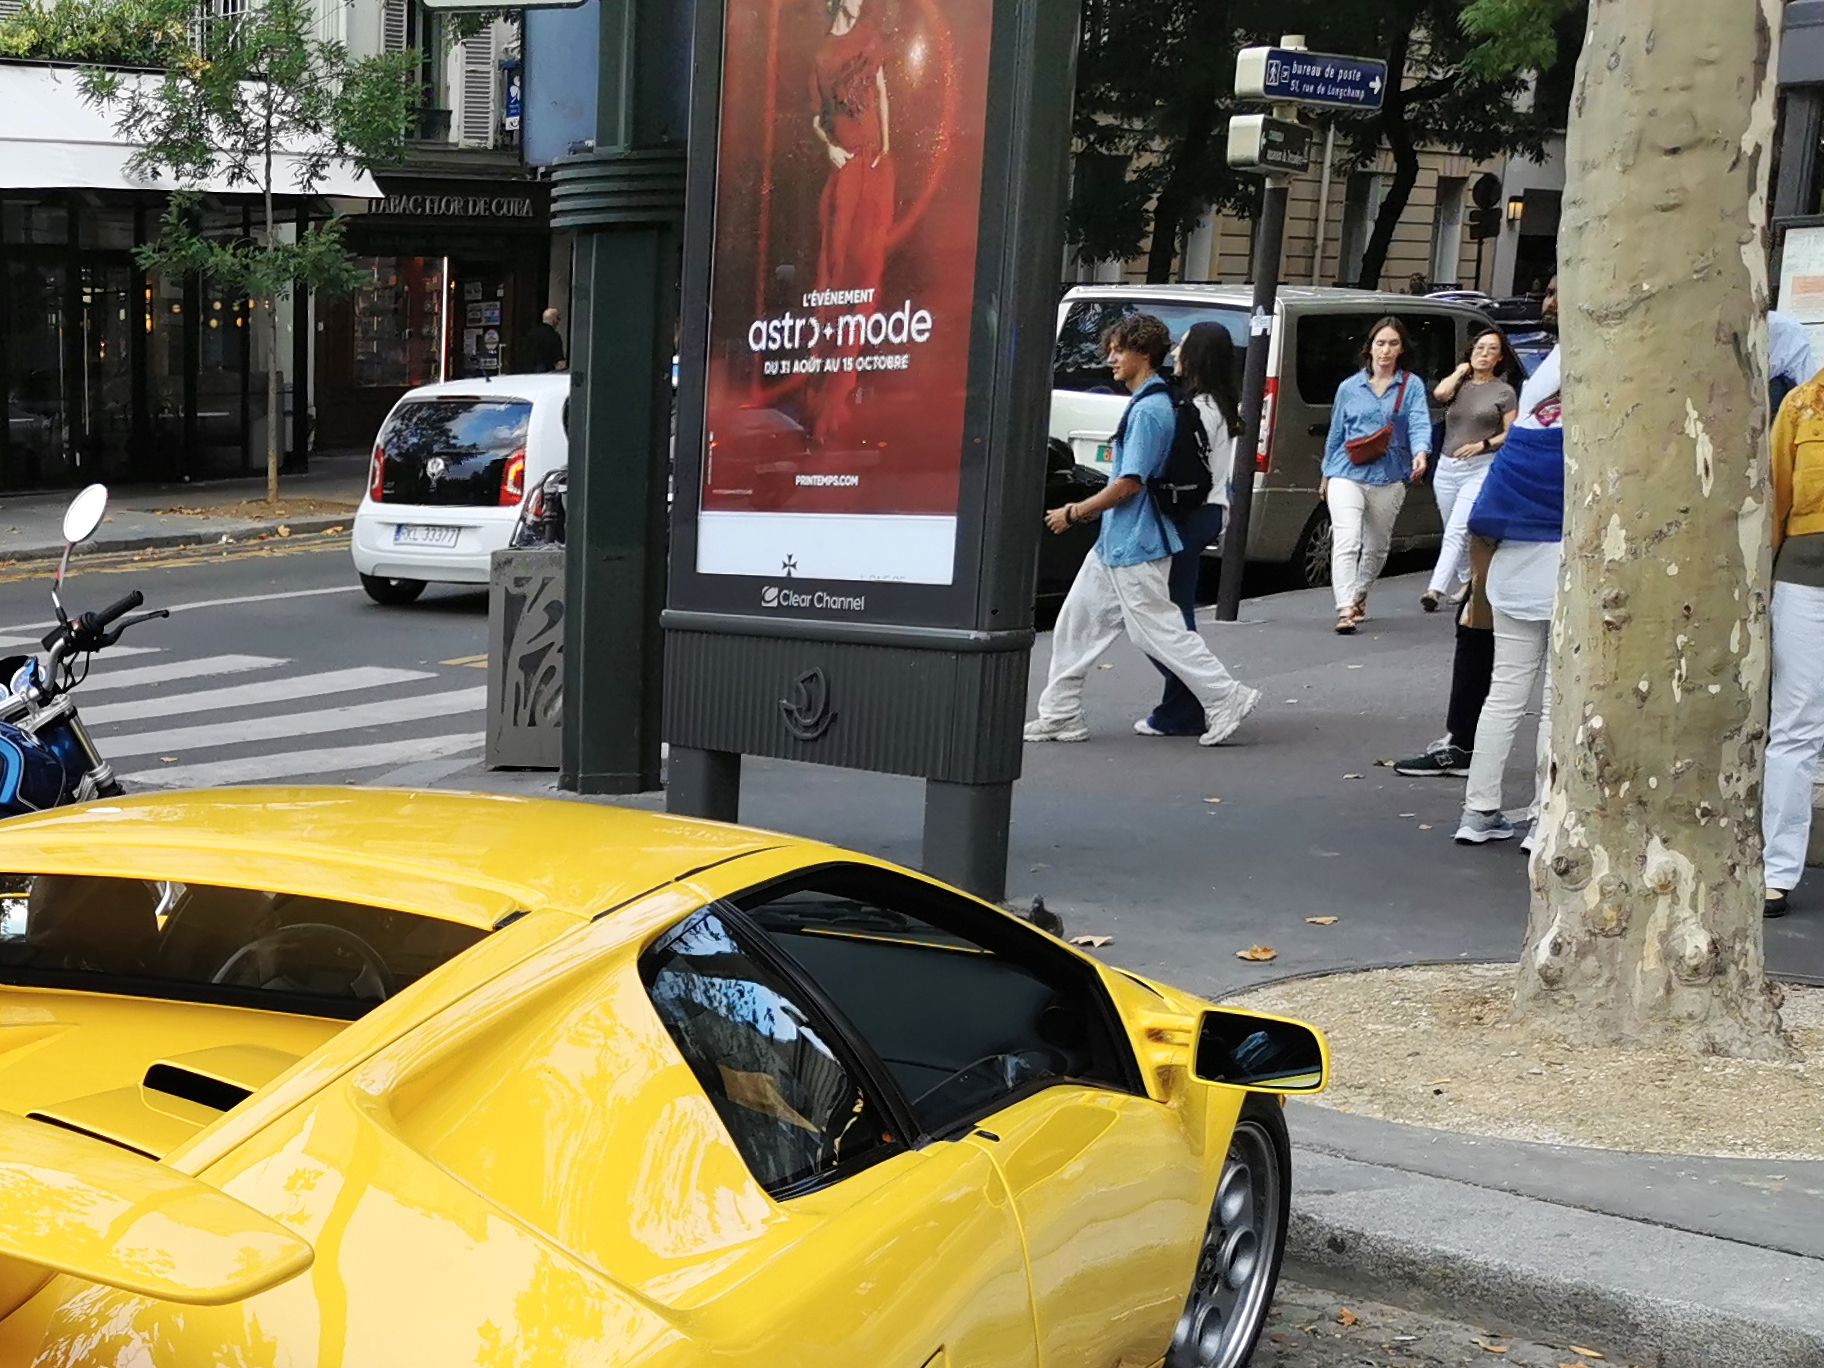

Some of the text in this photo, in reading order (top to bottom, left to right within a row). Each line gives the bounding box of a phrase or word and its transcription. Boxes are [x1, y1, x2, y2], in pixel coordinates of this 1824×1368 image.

[1291, 61, 1361, 82] bureau de poste
[1302, 83, 1314, 93] rue
[1316, 83, 1325, 94] de
[1327, 84, 1365, 101] Longchamp
[424, 195, 468, 216] FLOR
[468, 197, 490, 216] DE
[491, 197, 534, 217] CUBA
[764, 360, 779, 375] DU
[824, 357, 841, 372] AU
[842, 356, 854, 371] 15
[855, 354, 910, 371] OCTOBRE
[795, 475, 859, 487] PRINTEMPS.COM
[779, 590, 865, 611] Clear Channel
